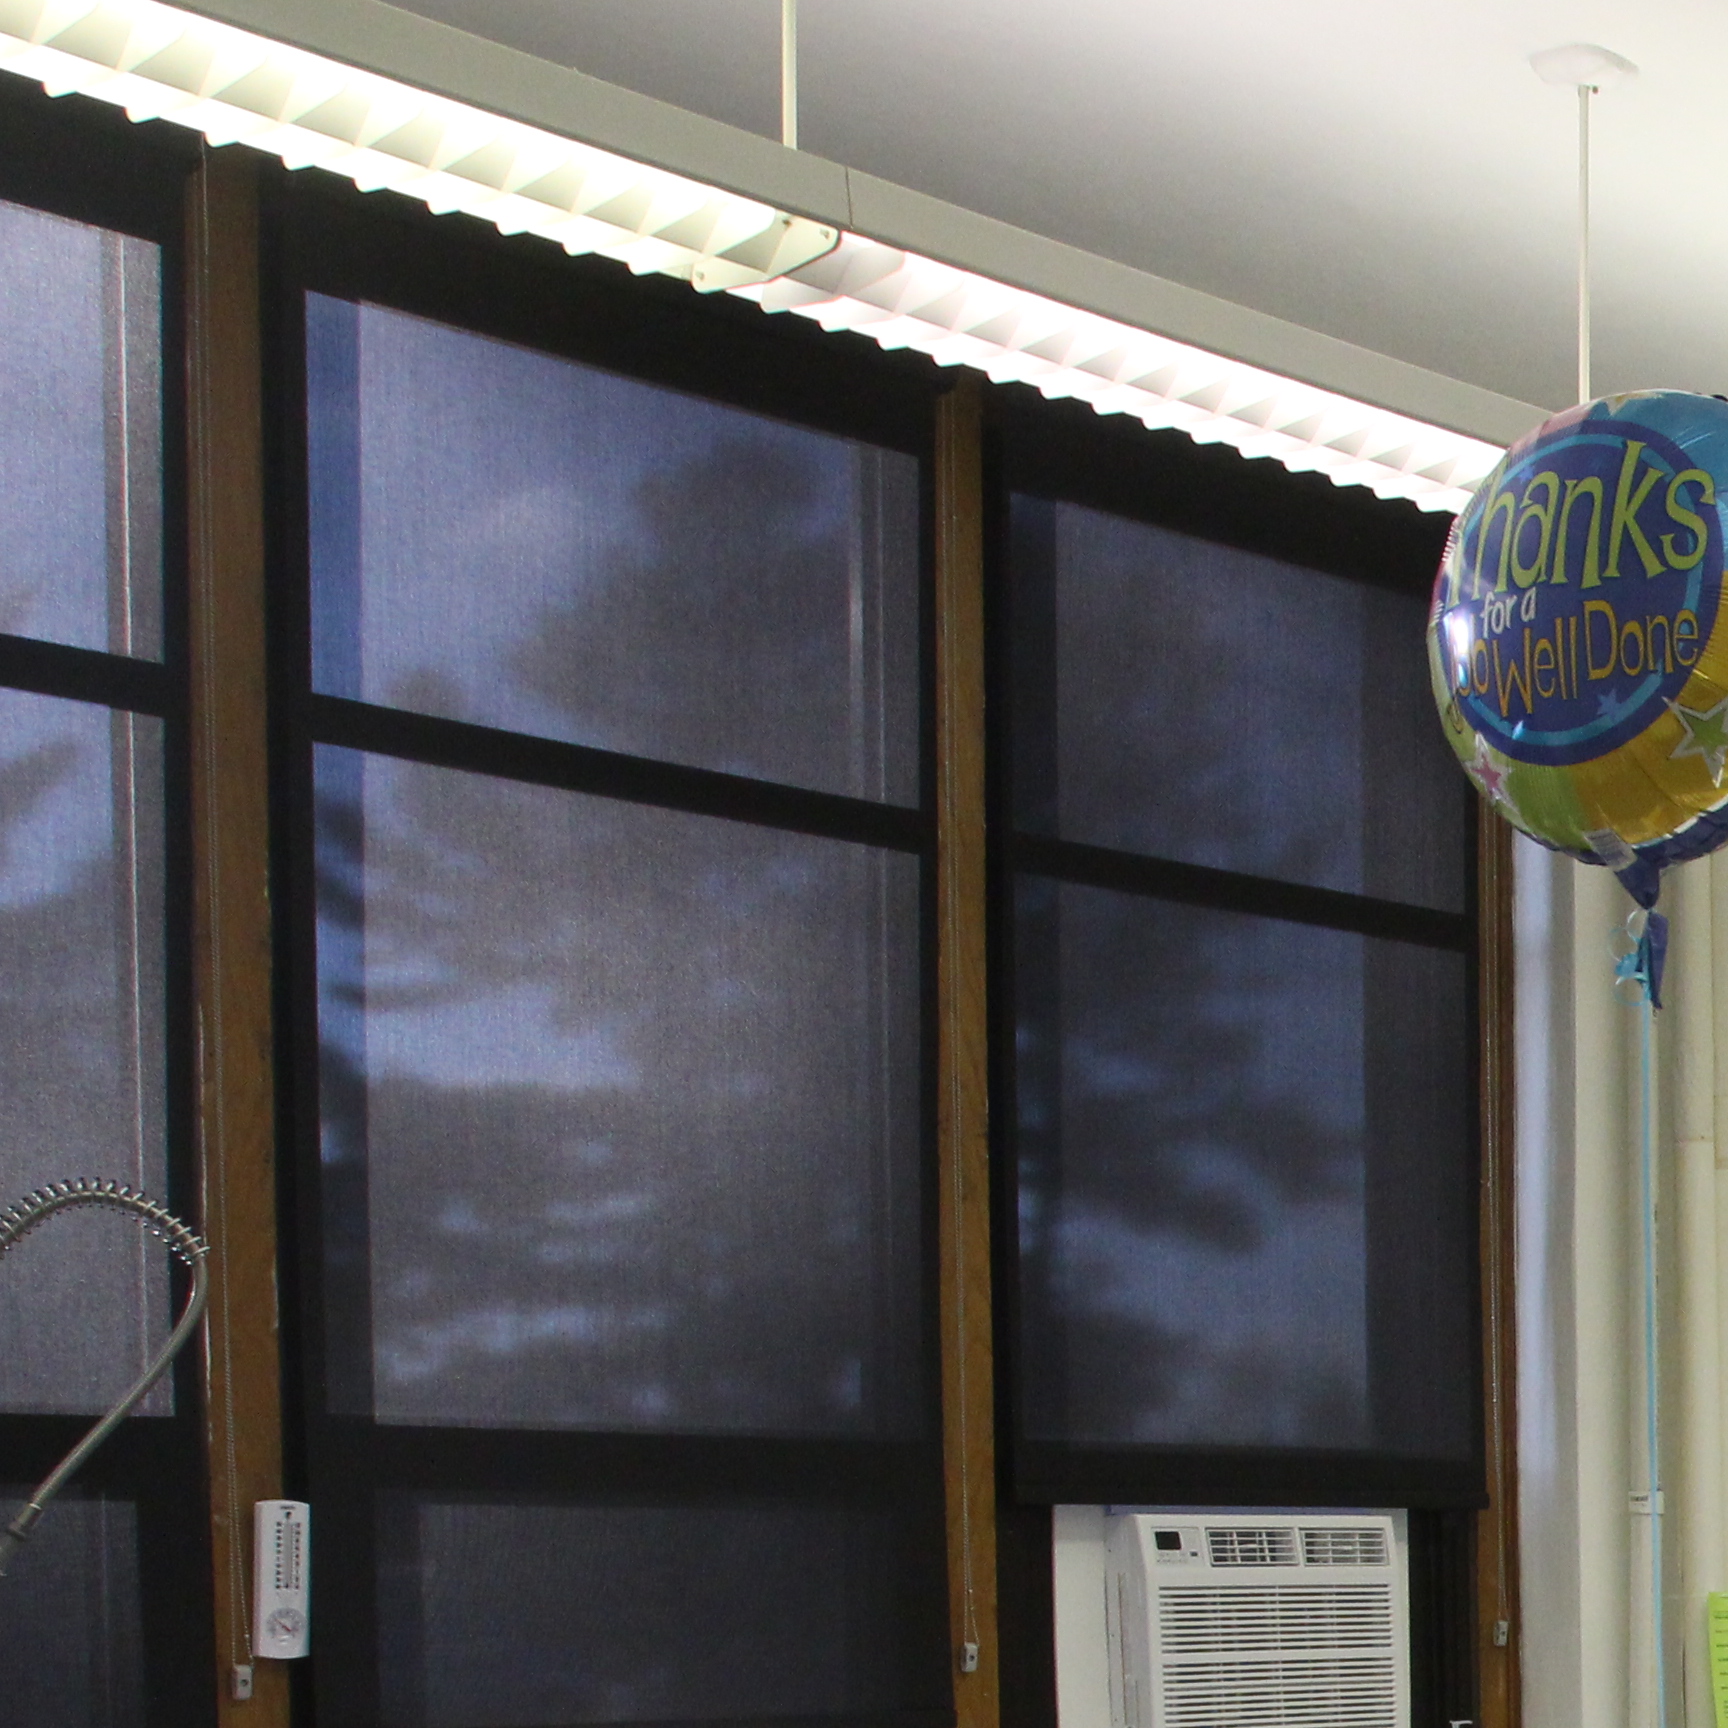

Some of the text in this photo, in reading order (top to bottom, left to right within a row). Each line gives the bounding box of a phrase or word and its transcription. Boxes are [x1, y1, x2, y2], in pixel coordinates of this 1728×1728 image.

[1480, 586, 1537, 639] for a
[1491, 616, 1578, 718] Well
[1583, 599, 1699, 681] Done
